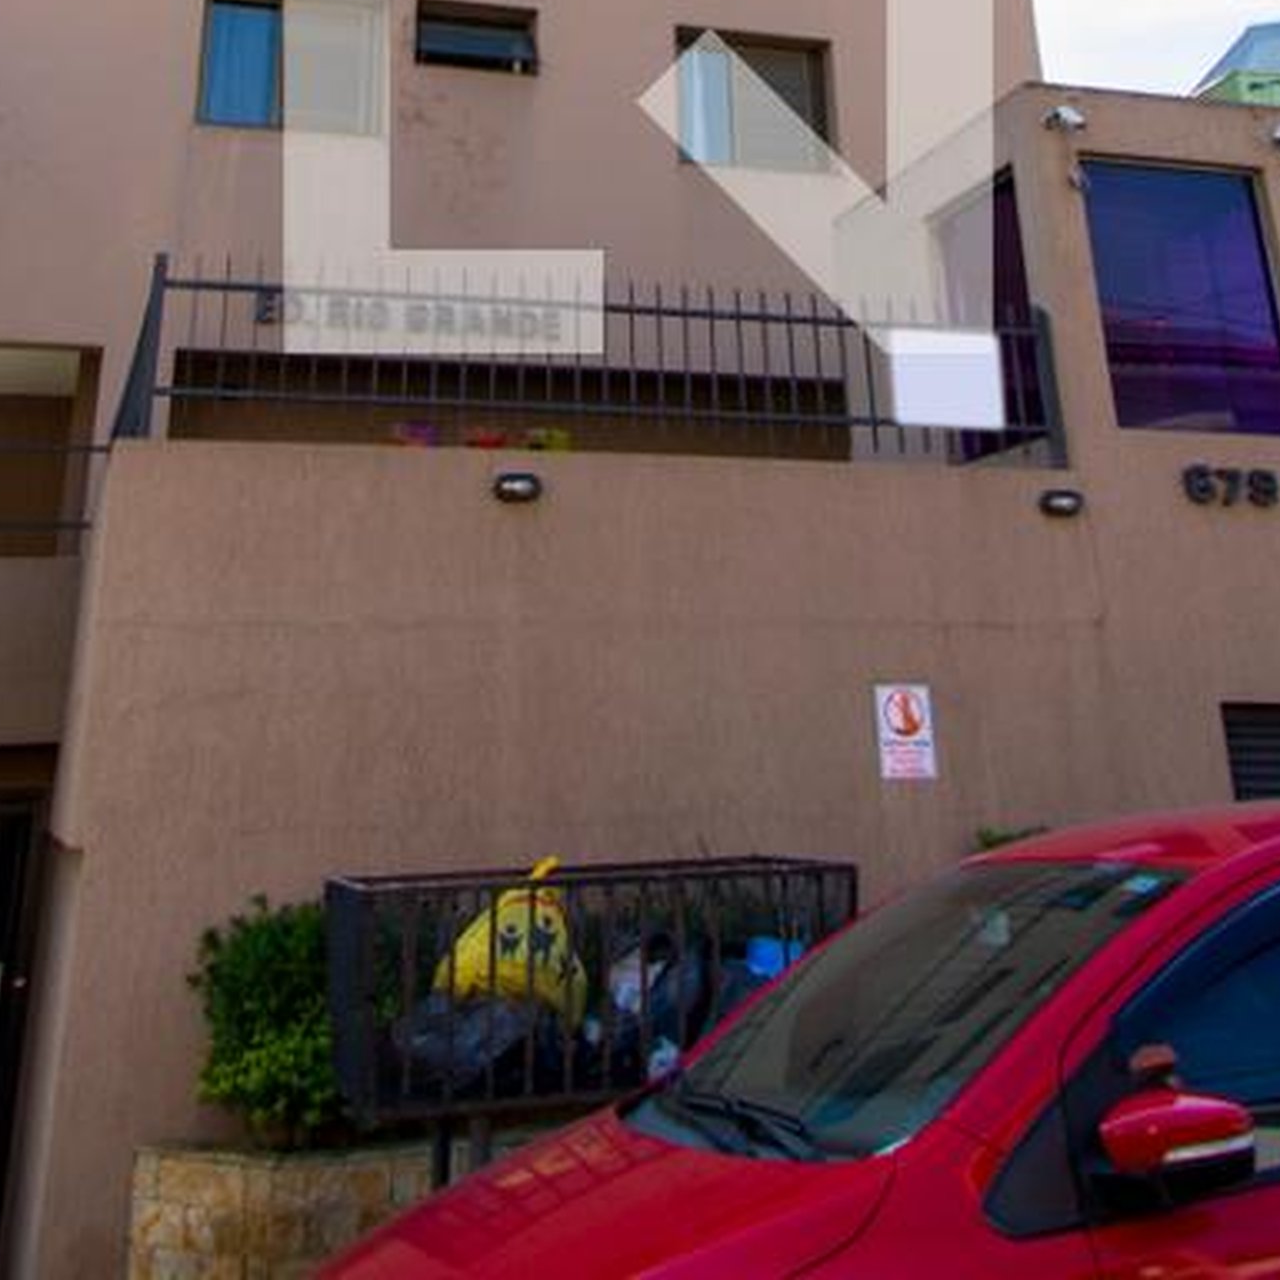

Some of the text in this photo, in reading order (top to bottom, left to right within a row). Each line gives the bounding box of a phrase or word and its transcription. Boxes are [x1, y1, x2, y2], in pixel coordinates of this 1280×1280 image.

[327, 297, 391, 332] RIO
[404, 302, 561, 341] GRANDE
[1182, 464, 1280, 507] 679
